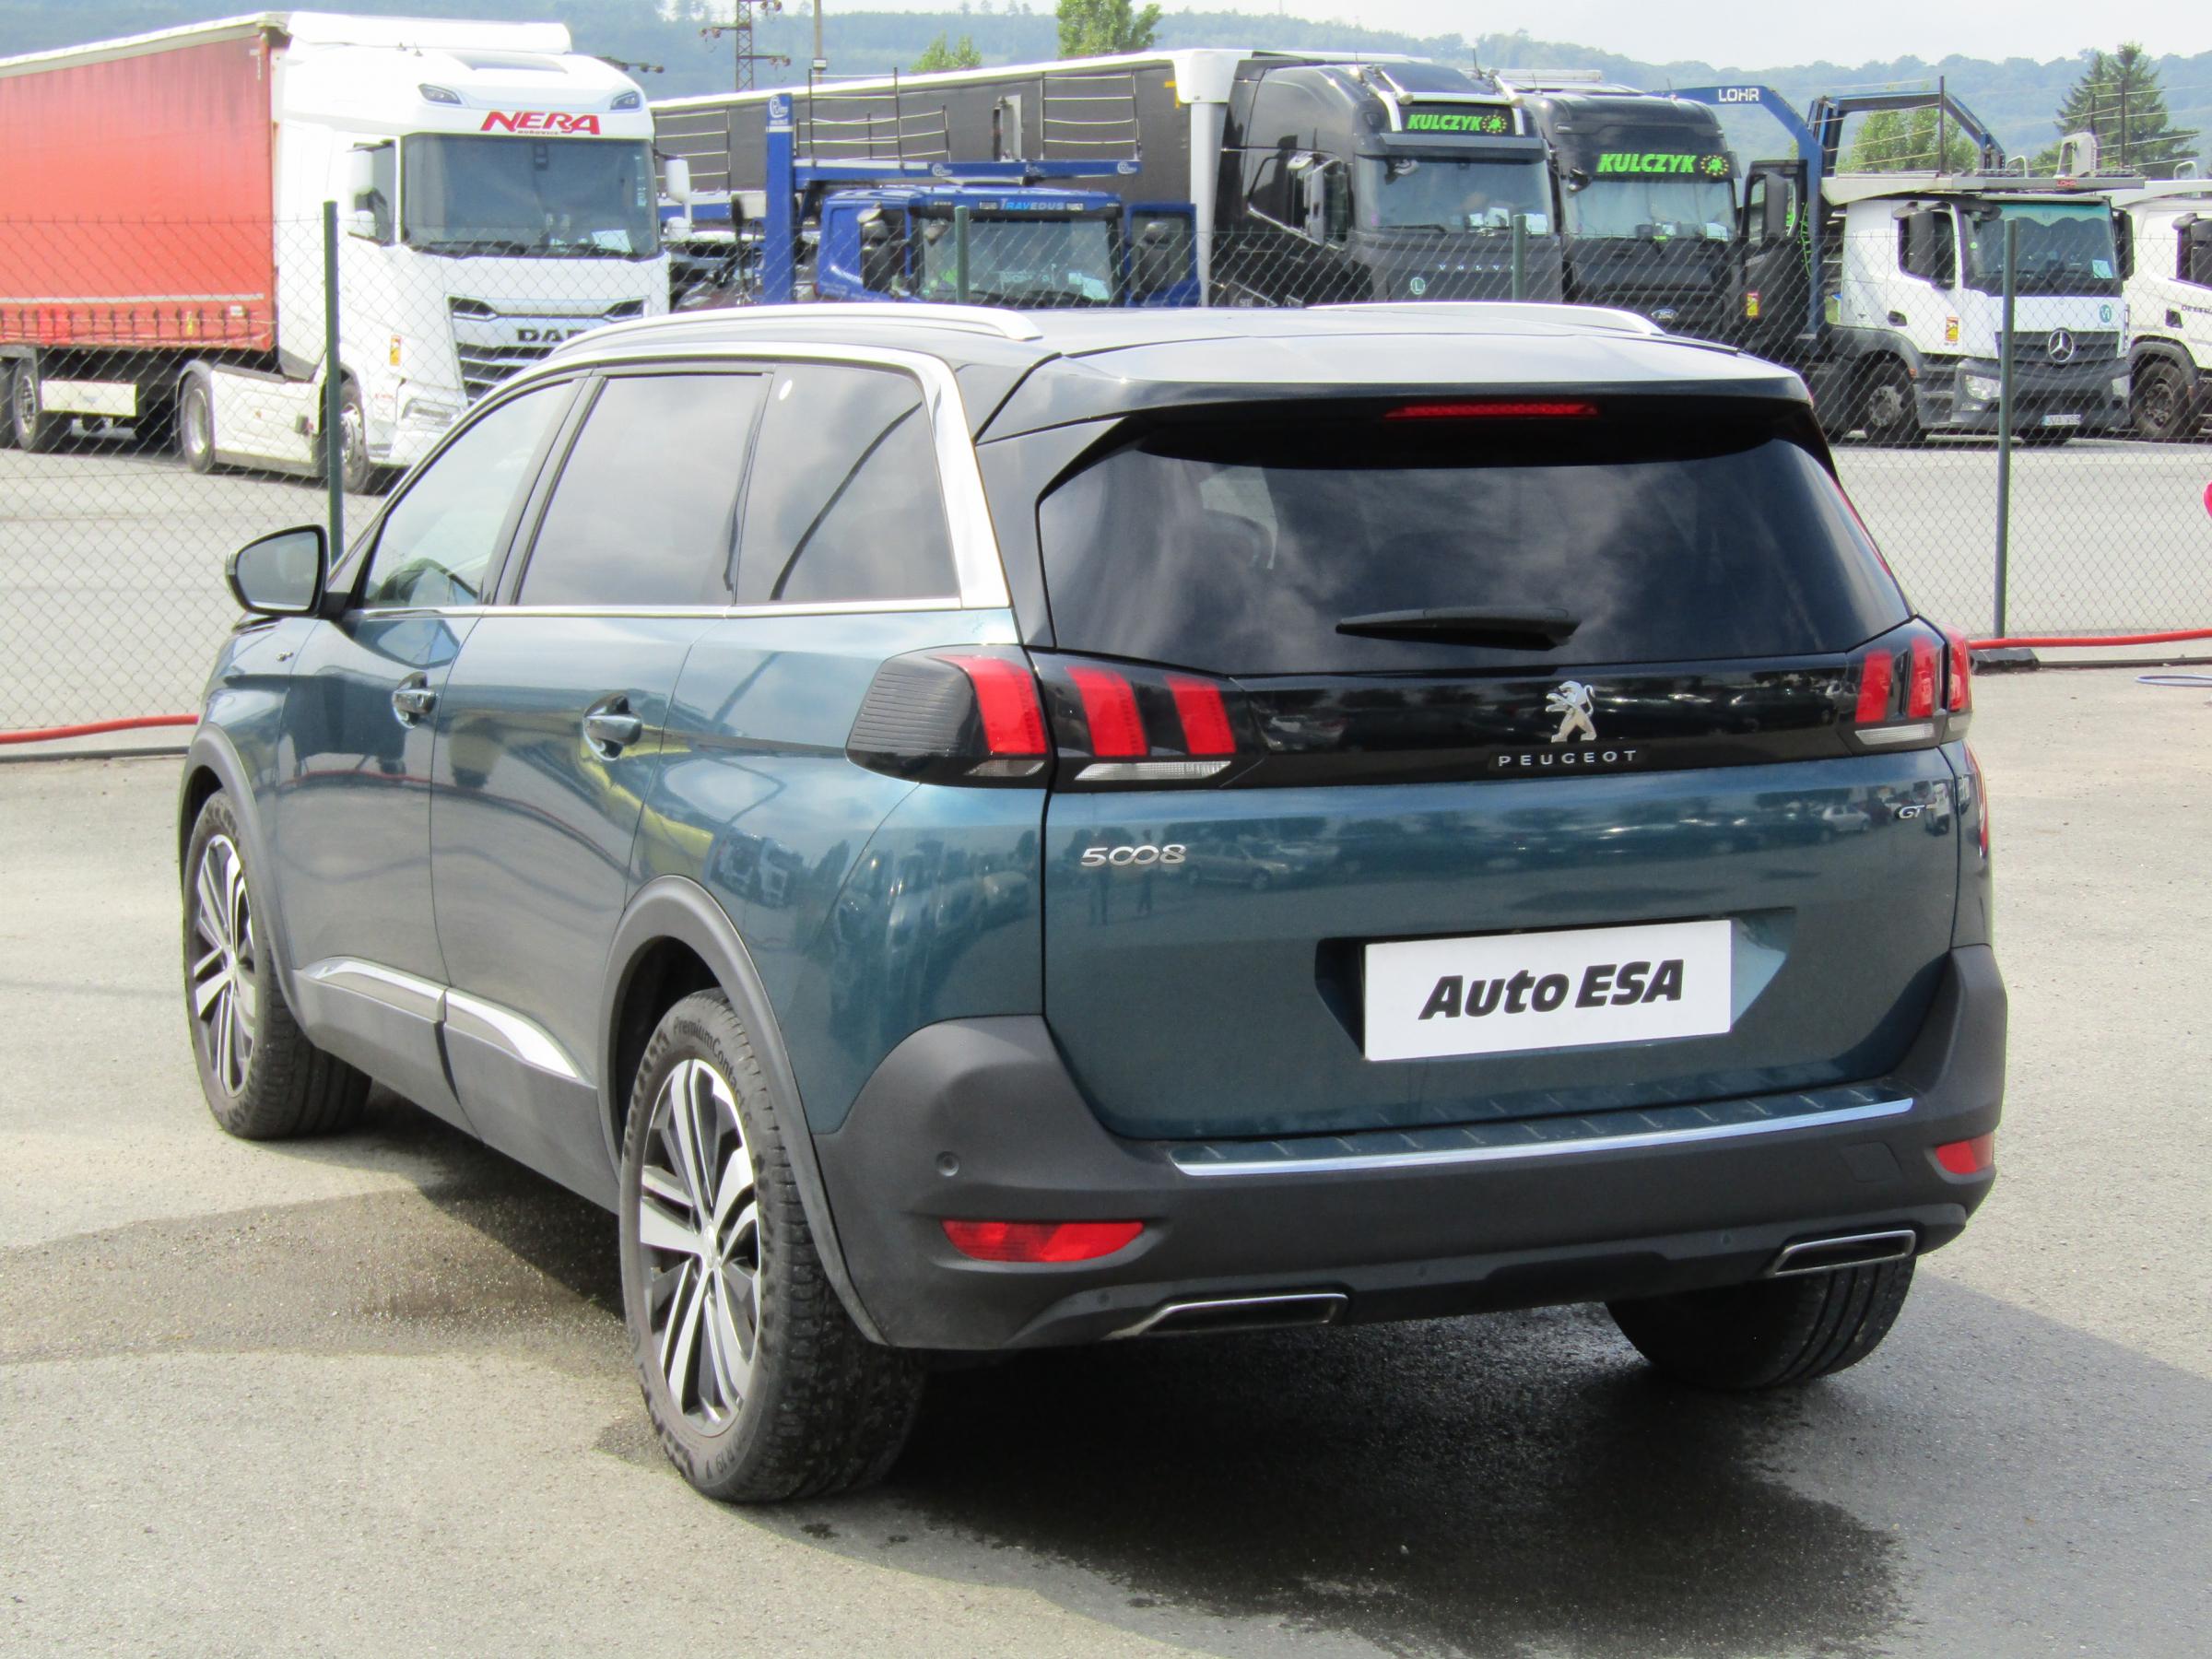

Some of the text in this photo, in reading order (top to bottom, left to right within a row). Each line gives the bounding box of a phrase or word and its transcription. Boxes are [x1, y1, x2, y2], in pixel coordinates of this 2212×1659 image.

[1718, 88, 1759, 102] LOHR
[480, 111, 601, 135] NERA
[1406, 113, 1483, 131] KULCZYK
[1596, 153, 1697, 173] KULCZYK
[1498, 750, 1636, 767] PEUGEOT
[1899, 805, 1925, 819] GT
[1080, 844, 1186, 866] 5008
[1418, 959, 1684, 1020] Auto ESA
